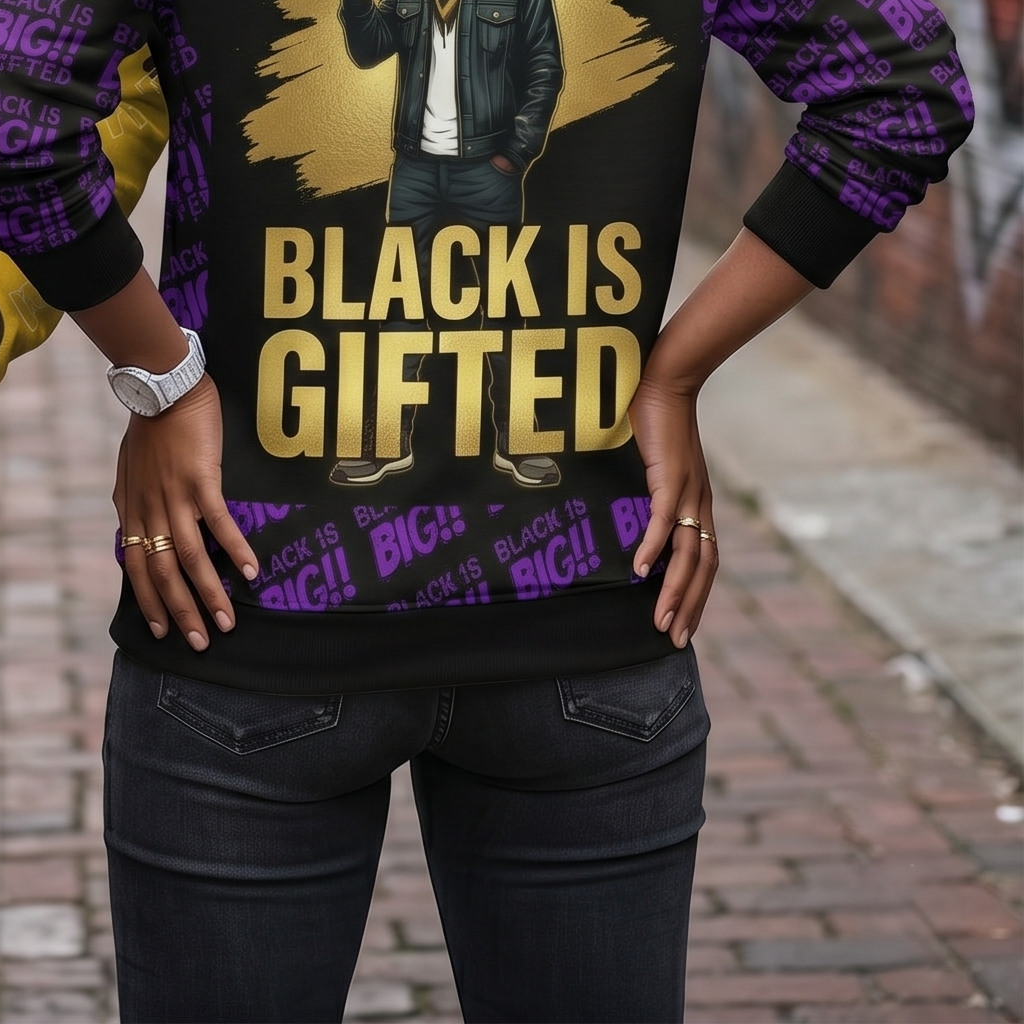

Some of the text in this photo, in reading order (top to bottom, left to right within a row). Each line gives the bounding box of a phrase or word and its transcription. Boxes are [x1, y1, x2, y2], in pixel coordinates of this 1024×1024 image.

[68, 3, 94, 27] IS
[39, 104, 62, 127] IS
[263, 221, 642, 321] BLACK IS
[256, 326, 642, 459] GIFTED
[370, 506, 467, 578] BIG!!
[493, 507, 562, 564] BLACK
[510, 517, 602, 601] BIG!!
[259, 546, 357, 612] BIG!!
